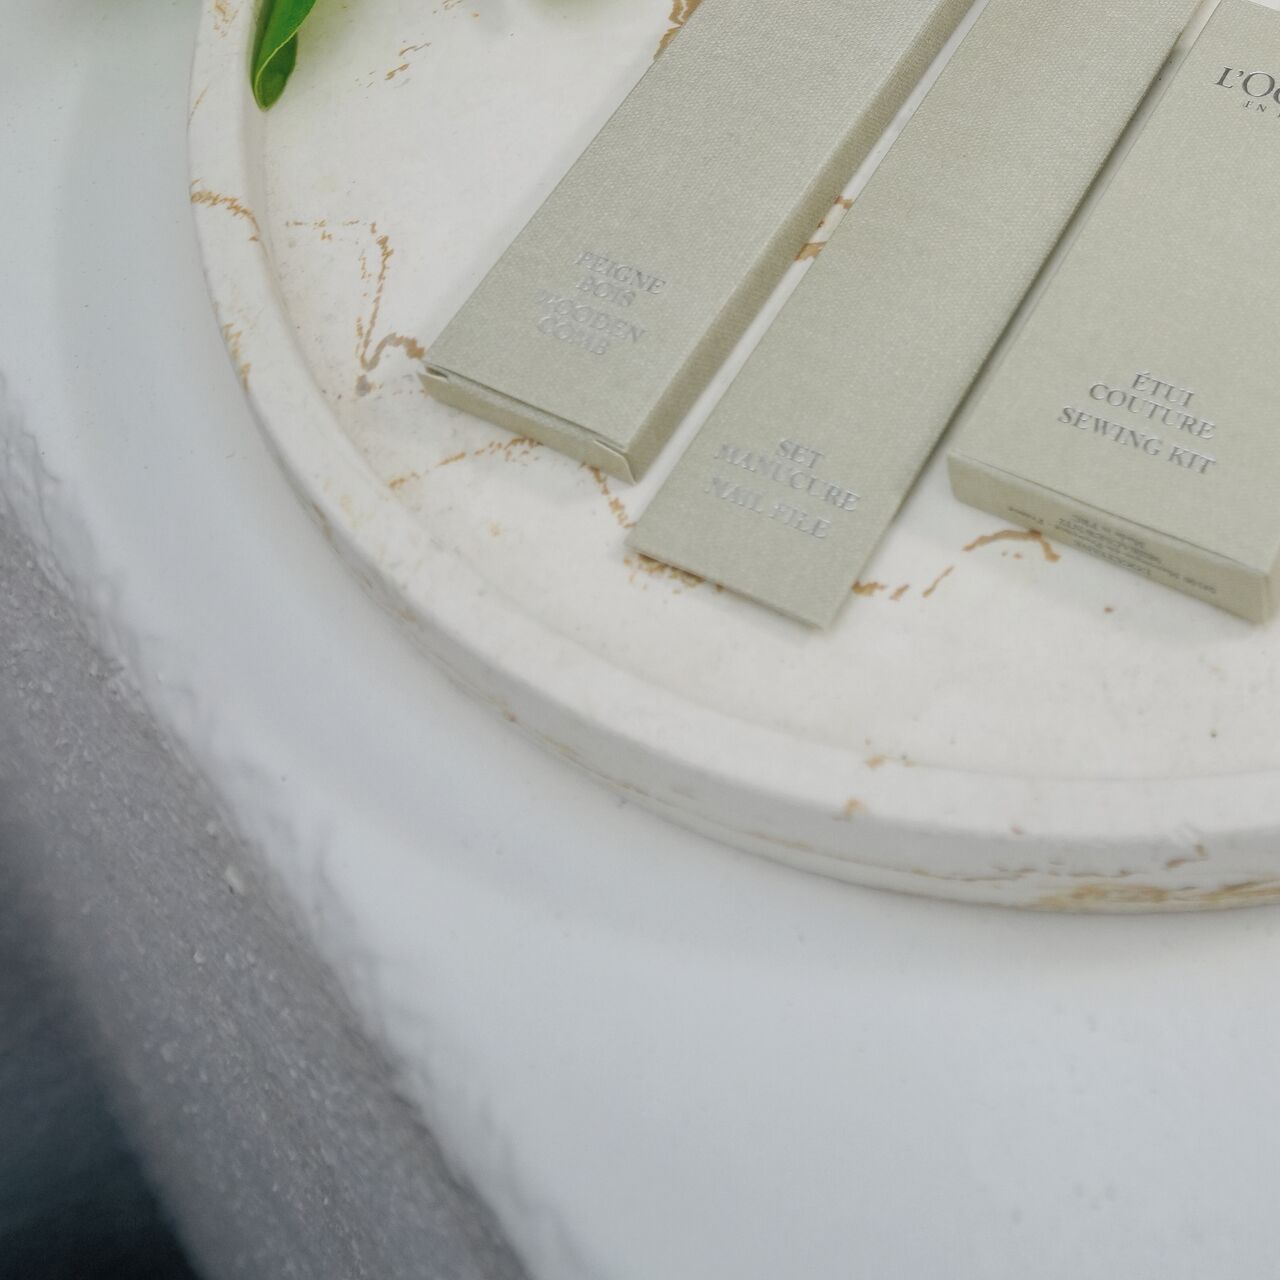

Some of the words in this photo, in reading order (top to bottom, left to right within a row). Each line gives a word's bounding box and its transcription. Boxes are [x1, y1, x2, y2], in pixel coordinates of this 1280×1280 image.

[1057, 406, 1162, 456] SEWING
[1168, 445, 1217, 475] KIT
[1089, 383, 1217, 440] COUTURE
